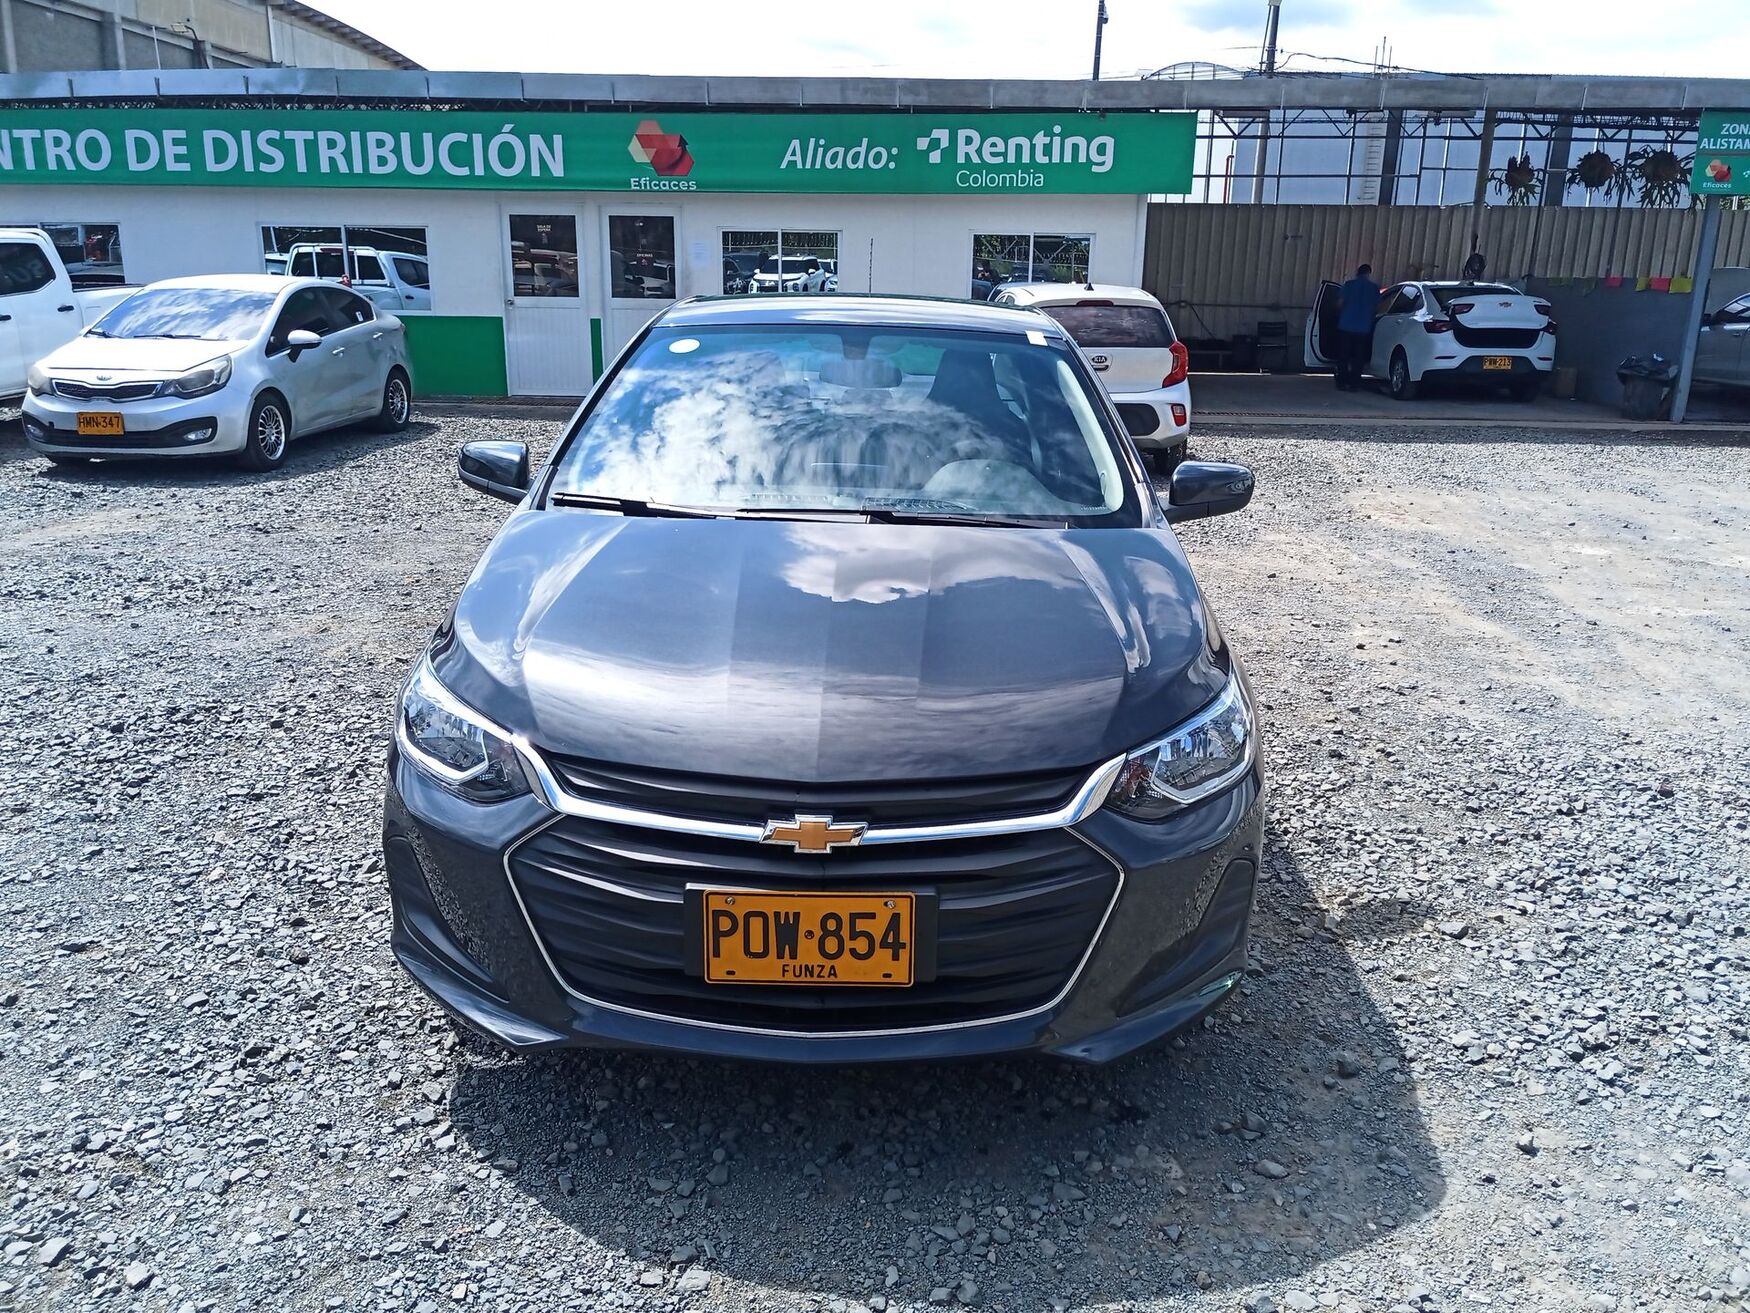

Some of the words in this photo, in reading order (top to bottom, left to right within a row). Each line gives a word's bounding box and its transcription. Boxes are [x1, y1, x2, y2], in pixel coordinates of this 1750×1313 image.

[1720, 123, 1750, 135] ZON
[124, 129, 191, 172] DE
[202, 124, 564, 178] DISTRIBUCIÓN
[780, 138, 898, 169] Aliado:
[956, 125, 1115, 173] Renting
[630, 177, 697, 190] Eficaces
[956, 169, 1044, 187] Colombia
[781, 964, 838, 979] FUNZA
